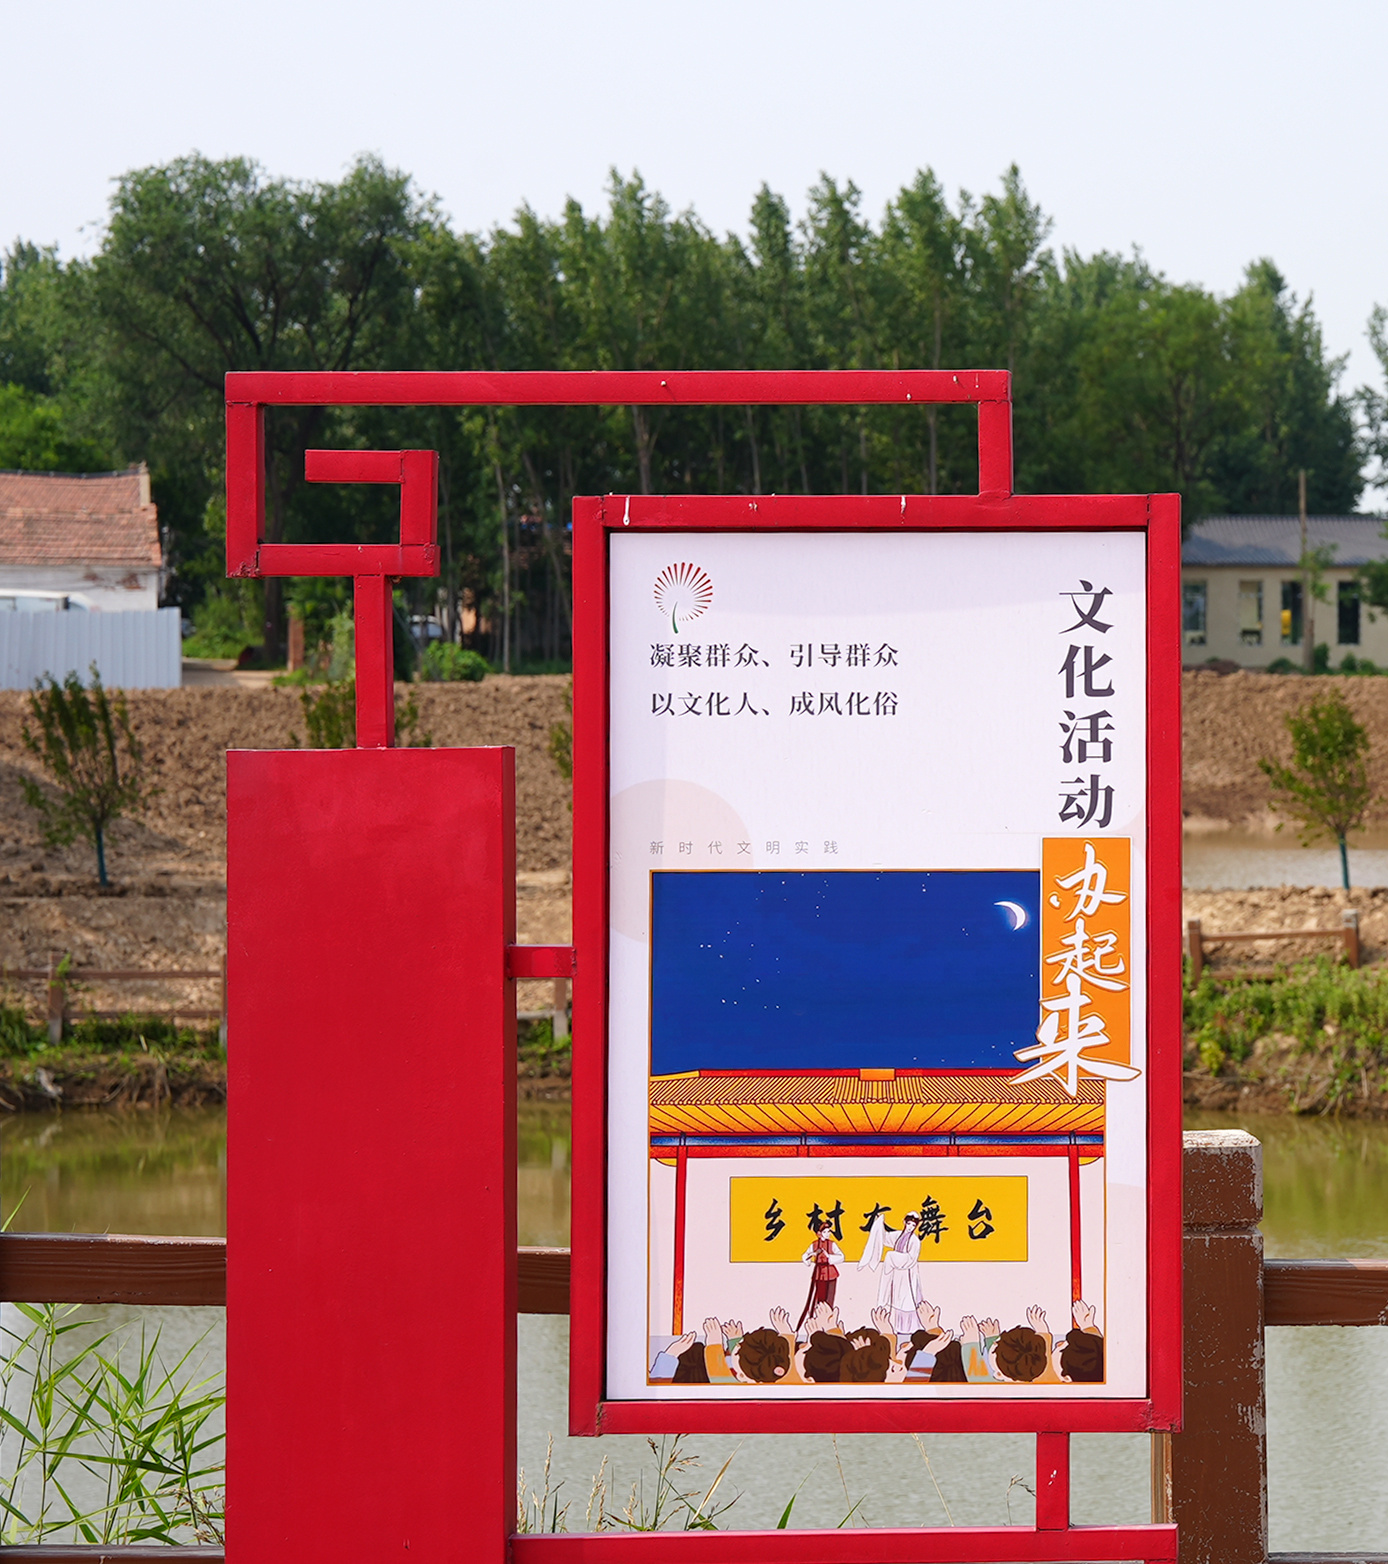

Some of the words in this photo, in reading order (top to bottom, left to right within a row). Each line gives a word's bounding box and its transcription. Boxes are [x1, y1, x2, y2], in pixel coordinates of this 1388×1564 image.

[649, 642, 900, 669] 凝聚群众、引导群众
[650, 691, 899, 717] 以文化人、成风化俗
[1058, 579, 1115, 830] 文化活动
[649, 839, 839, 857] 新时代文明实践
[1010, 843, 1142, 1097] 办起来
